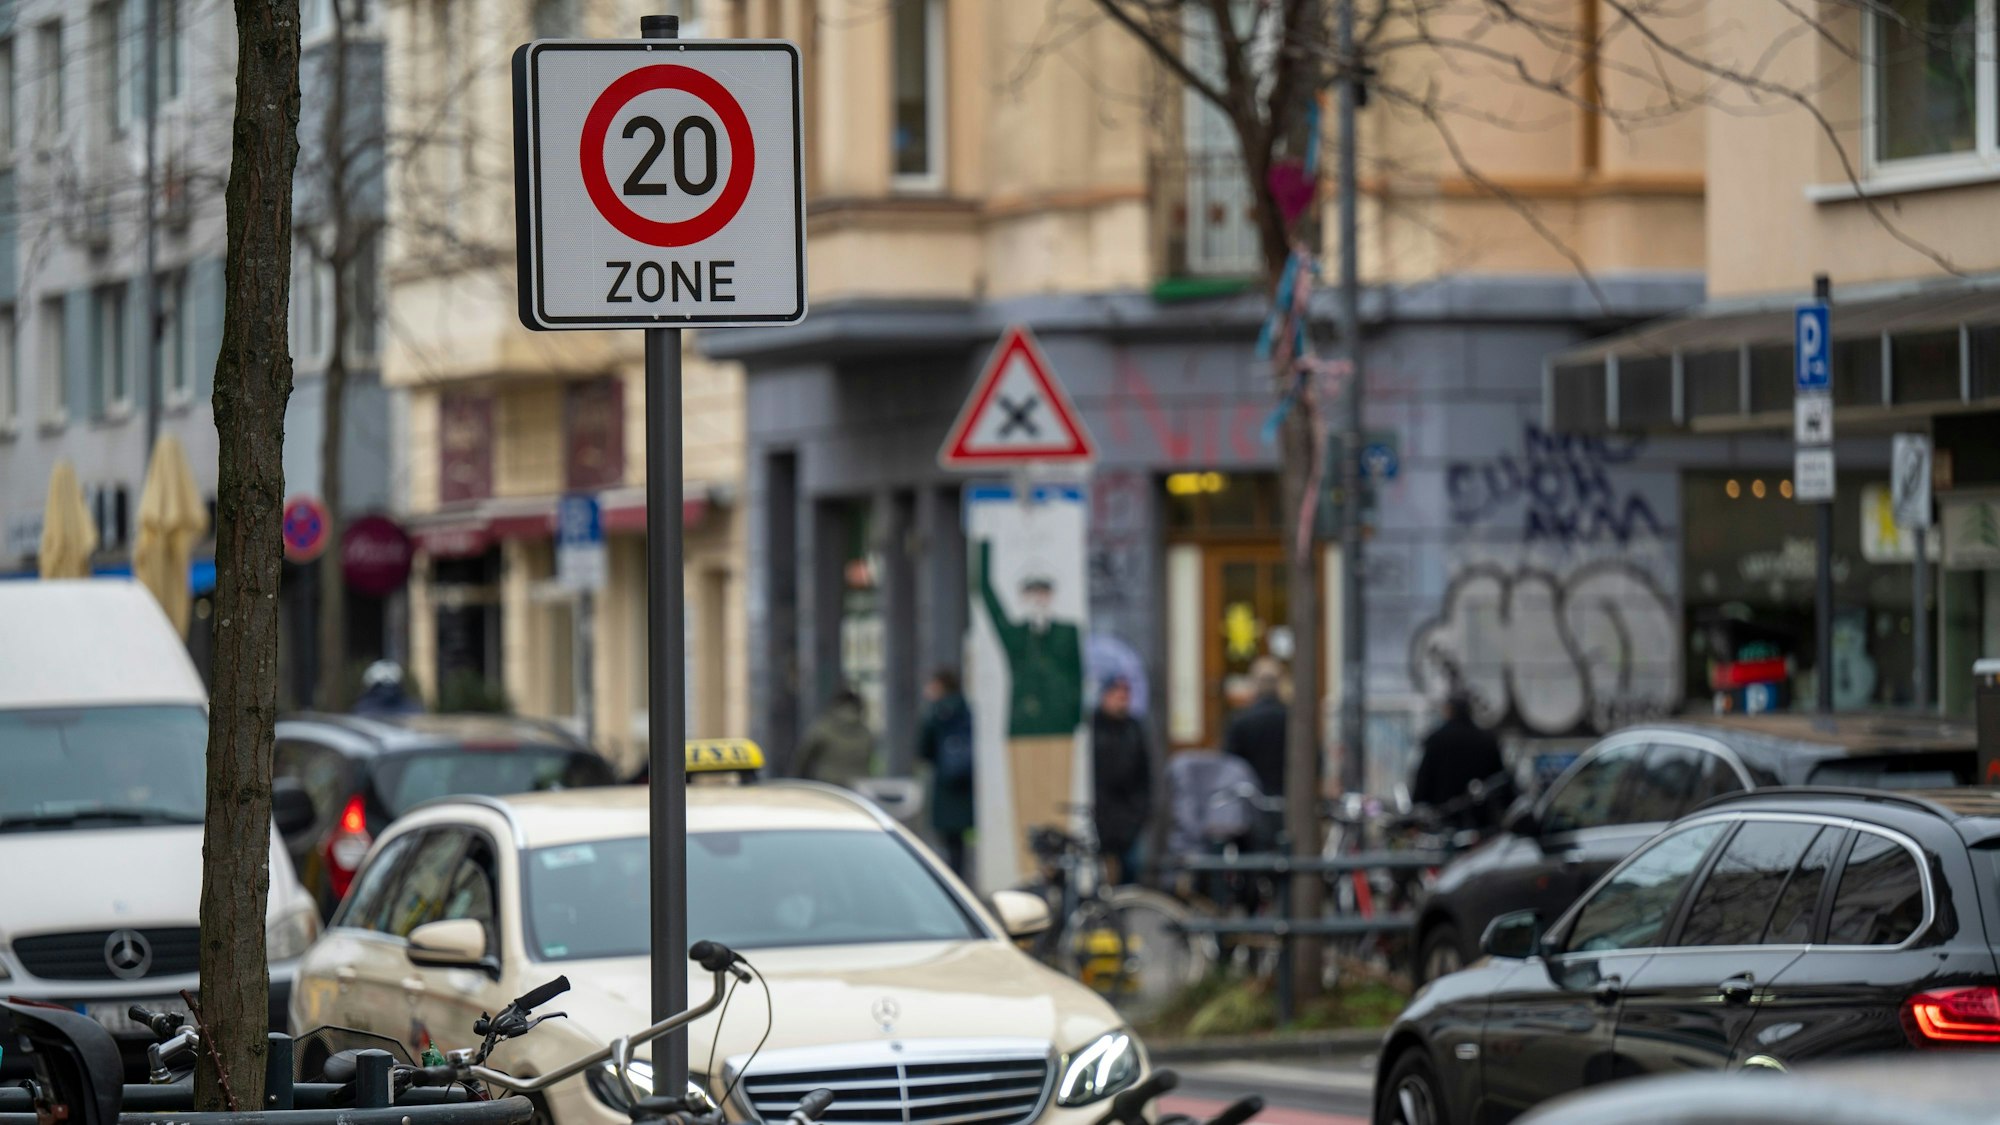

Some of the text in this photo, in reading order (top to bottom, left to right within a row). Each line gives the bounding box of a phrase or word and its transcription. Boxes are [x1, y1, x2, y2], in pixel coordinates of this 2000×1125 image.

[622, 115, 717, 195] 20
[606, 260, 735, 302] ZONE
[1800, 312, 1822, 383] P
